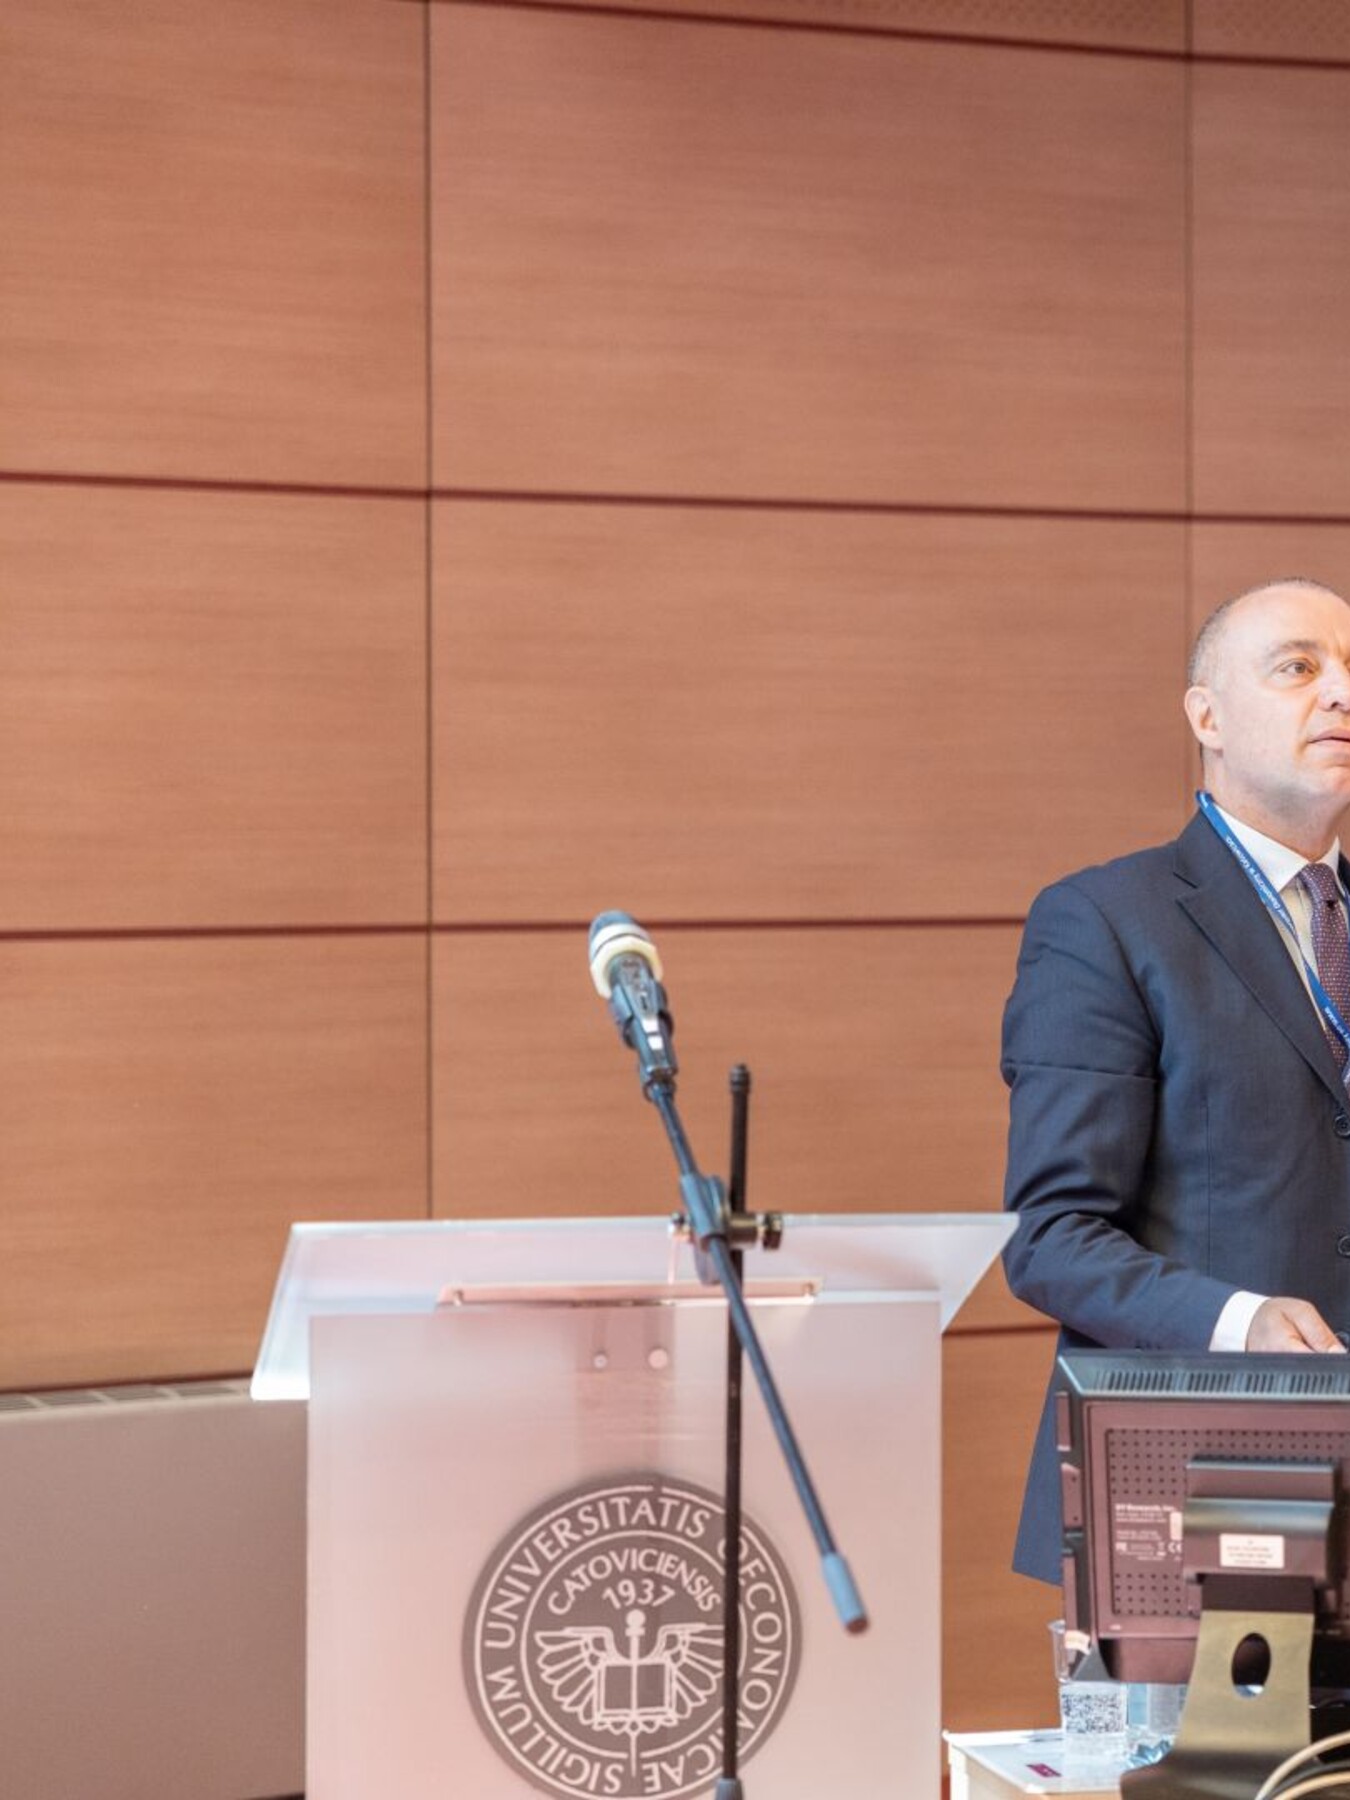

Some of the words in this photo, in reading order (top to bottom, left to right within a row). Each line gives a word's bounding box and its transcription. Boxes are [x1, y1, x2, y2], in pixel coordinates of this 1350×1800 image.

[484, 1497, 711, 1649] UNIVERSITATIS
[547, 1548, 722, 1615] CATOVICIENSIS
[602, 1578, 676, 1610] 1937
[485, 1666, 624, 1794] SIGILLUM
